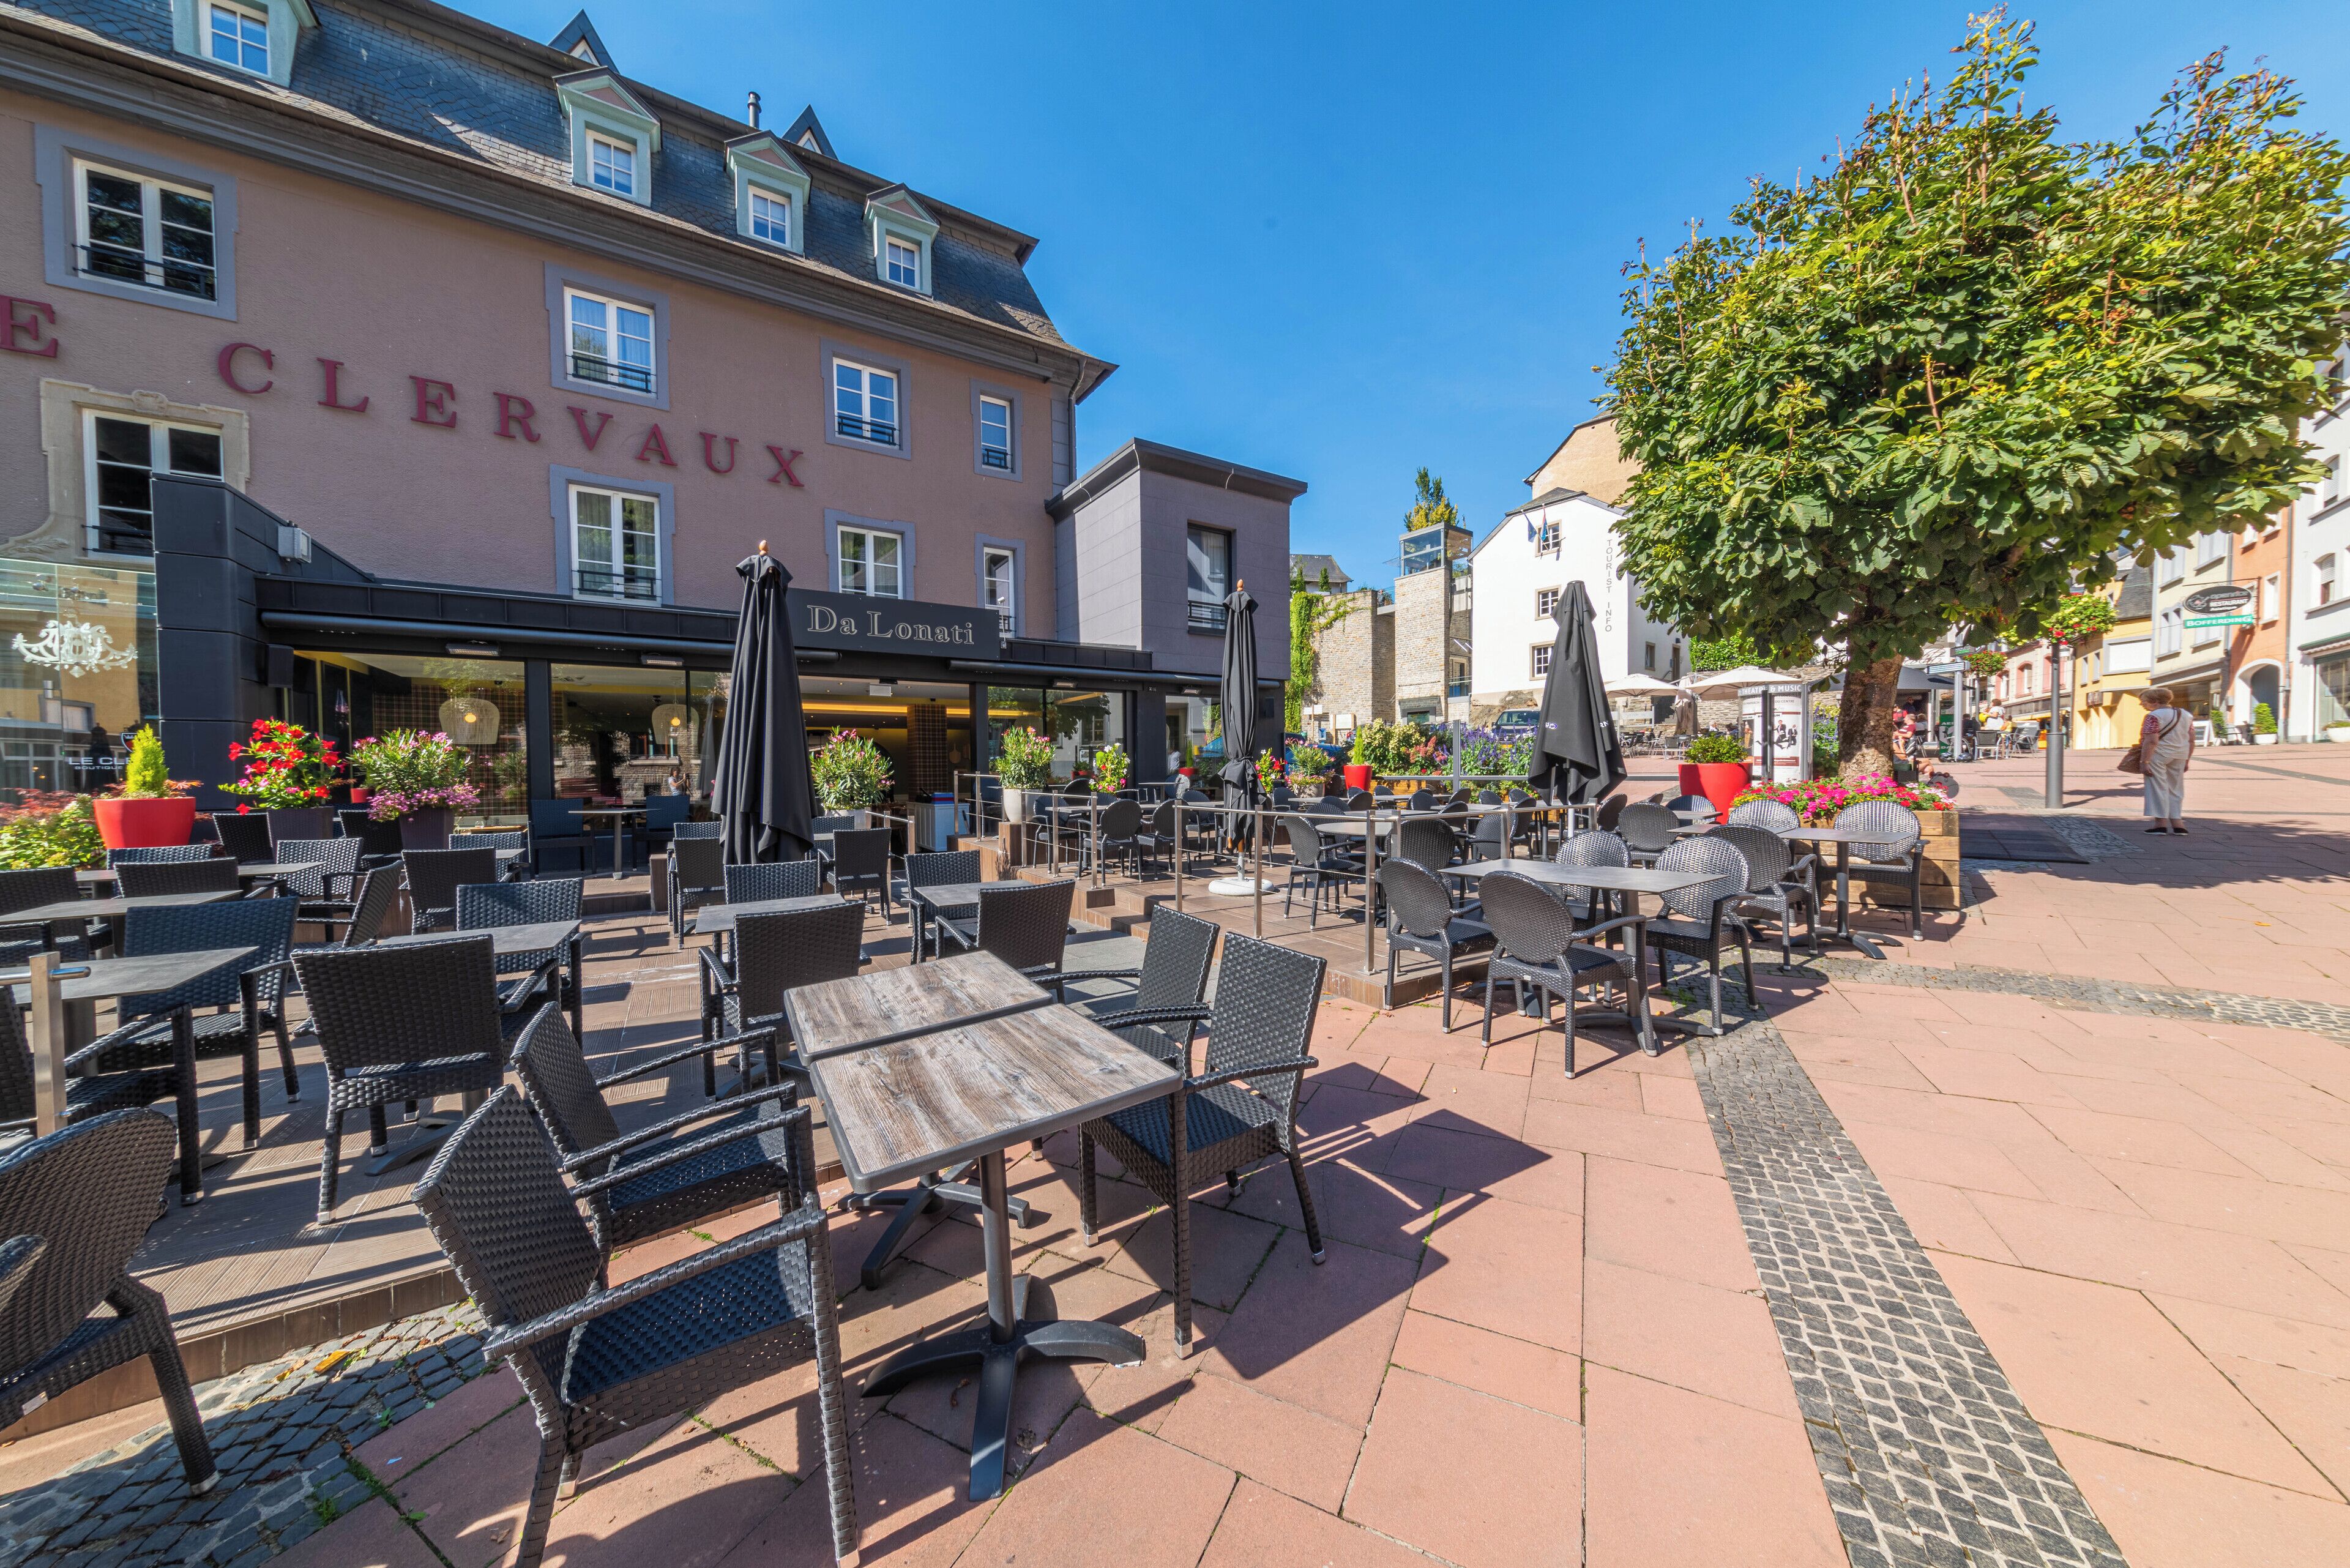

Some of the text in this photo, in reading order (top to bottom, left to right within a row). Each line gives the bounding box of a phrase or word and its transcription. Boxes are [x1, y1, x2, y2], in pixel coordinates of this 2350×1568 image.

[218, 342, 805, 487] CLERVAUX
[807, 605, 975, 645] Da Lonati
[2187, 616, 2252, 626] BOFFERDING
[68, 756, 94, 765] LE
